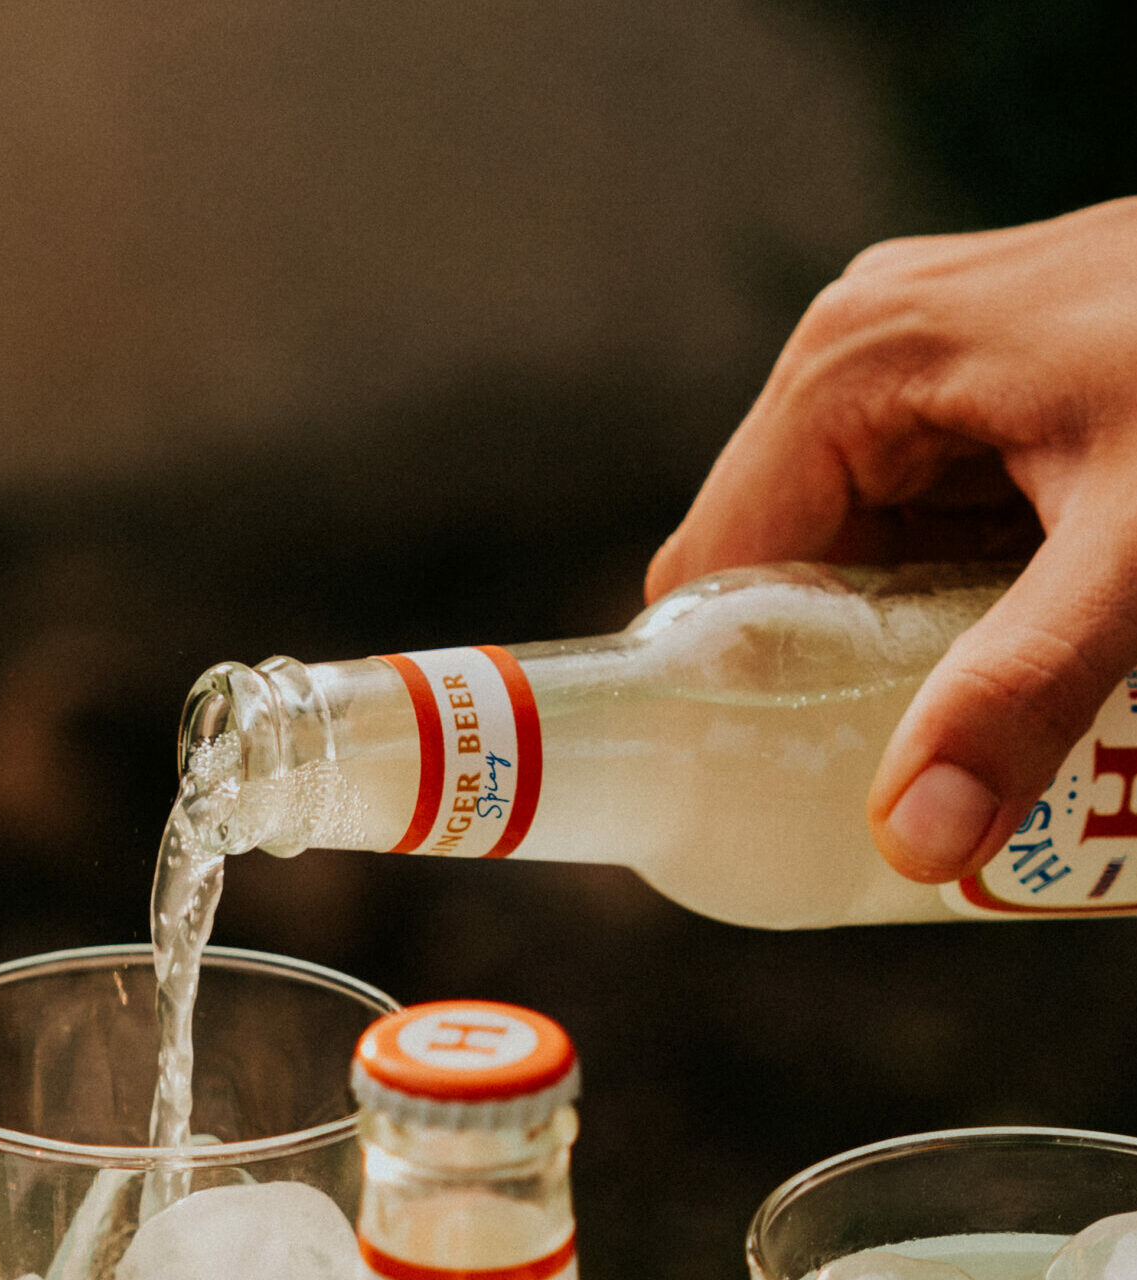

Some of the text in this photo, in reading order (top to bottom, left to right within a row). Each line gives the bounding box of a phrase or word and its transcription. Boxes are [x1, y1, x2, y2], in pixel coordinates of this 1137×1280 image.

[427, 673, 482, 857] INGER BEER
[476, 752, 511, 819] Spicy
[1008, 777, 1072, 893] HYS
[426, 1021, 508, 1056] H
